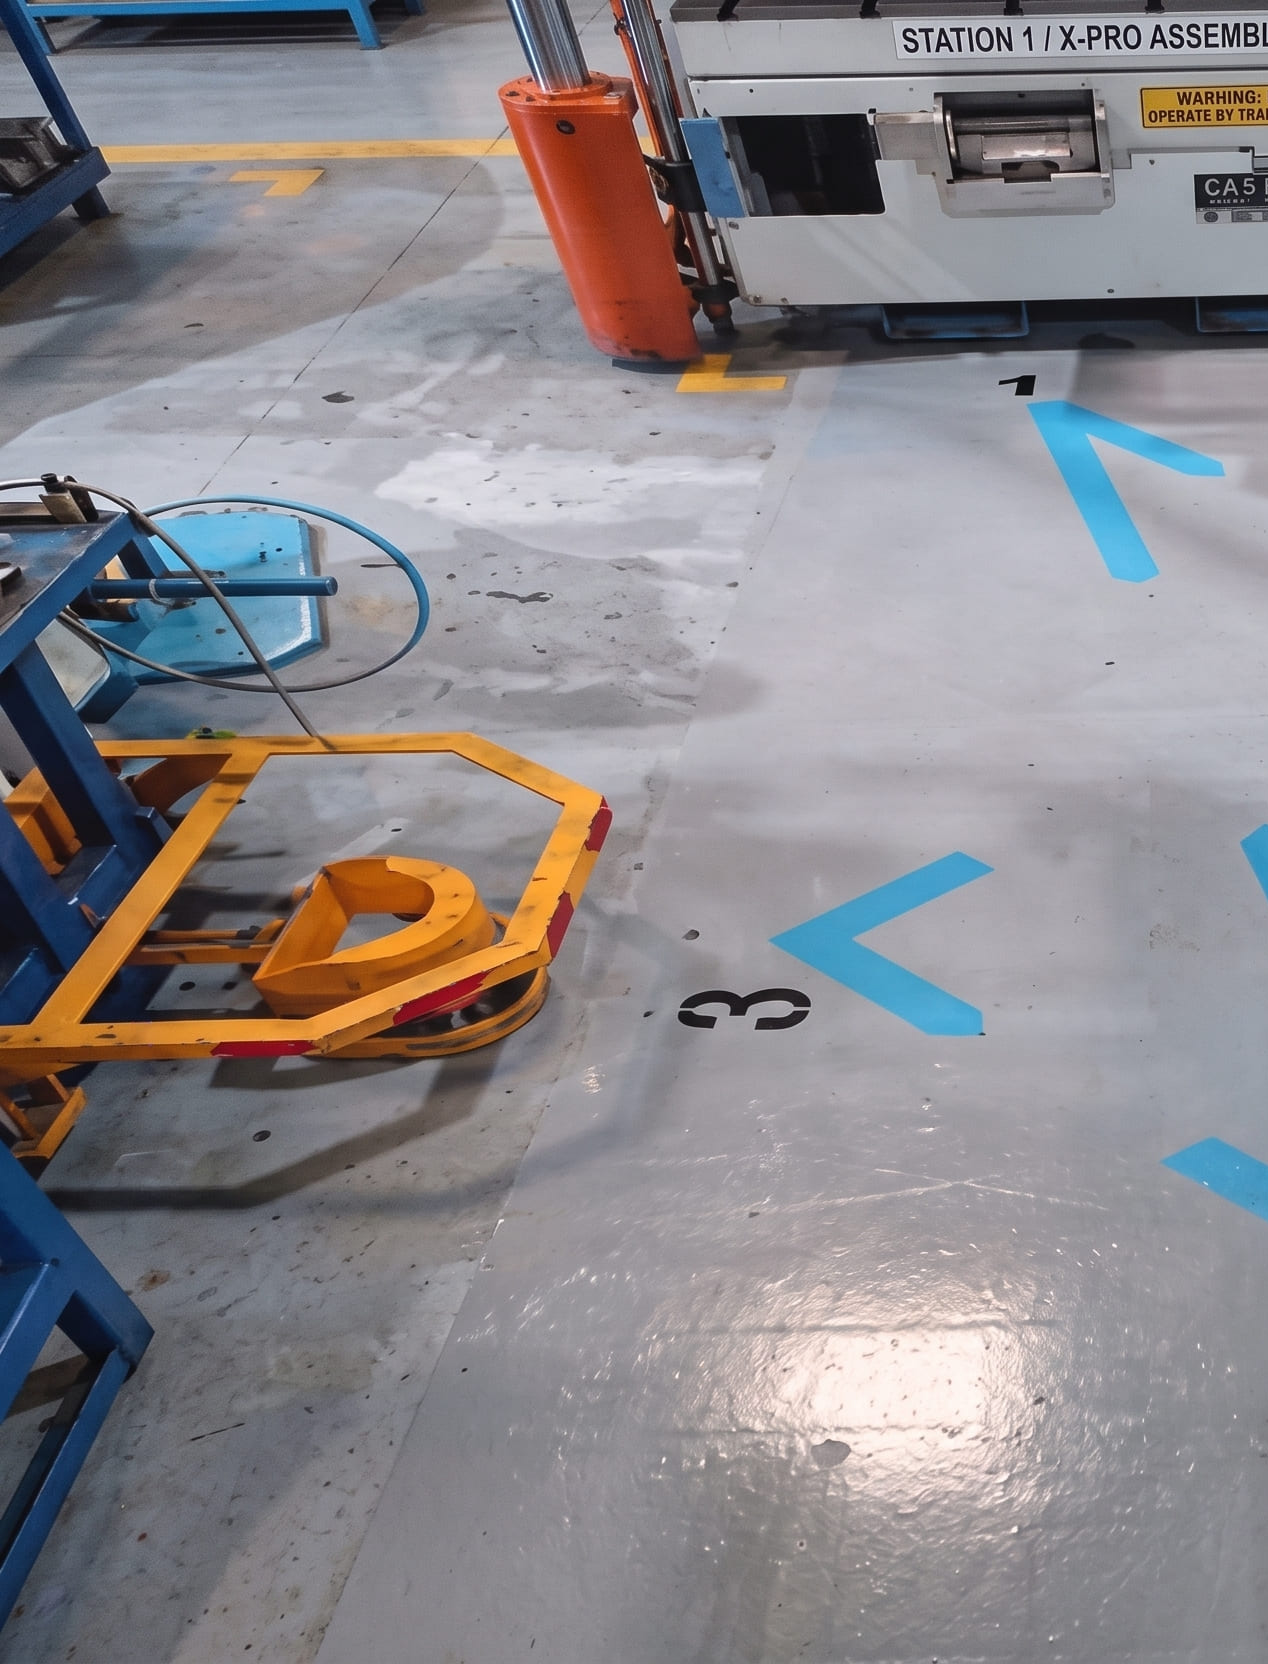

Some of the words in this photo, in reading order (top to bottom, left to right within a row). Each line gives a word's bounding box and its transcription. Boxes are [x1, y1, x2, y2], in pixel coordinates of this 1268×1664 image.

[902, 26, 1013, 53] STATION
[1022, 26, 1033, 51] 1
[1043, 25, 1051, 51] /
[1059, 24, 1142, 51] X-PRO
[1148, 109, 1213, 123] OPERATE
[1216, 108, 1234, 122] BY
[998, 374, 1037, 396] 1
[677, 987, 812, 1031] 3
